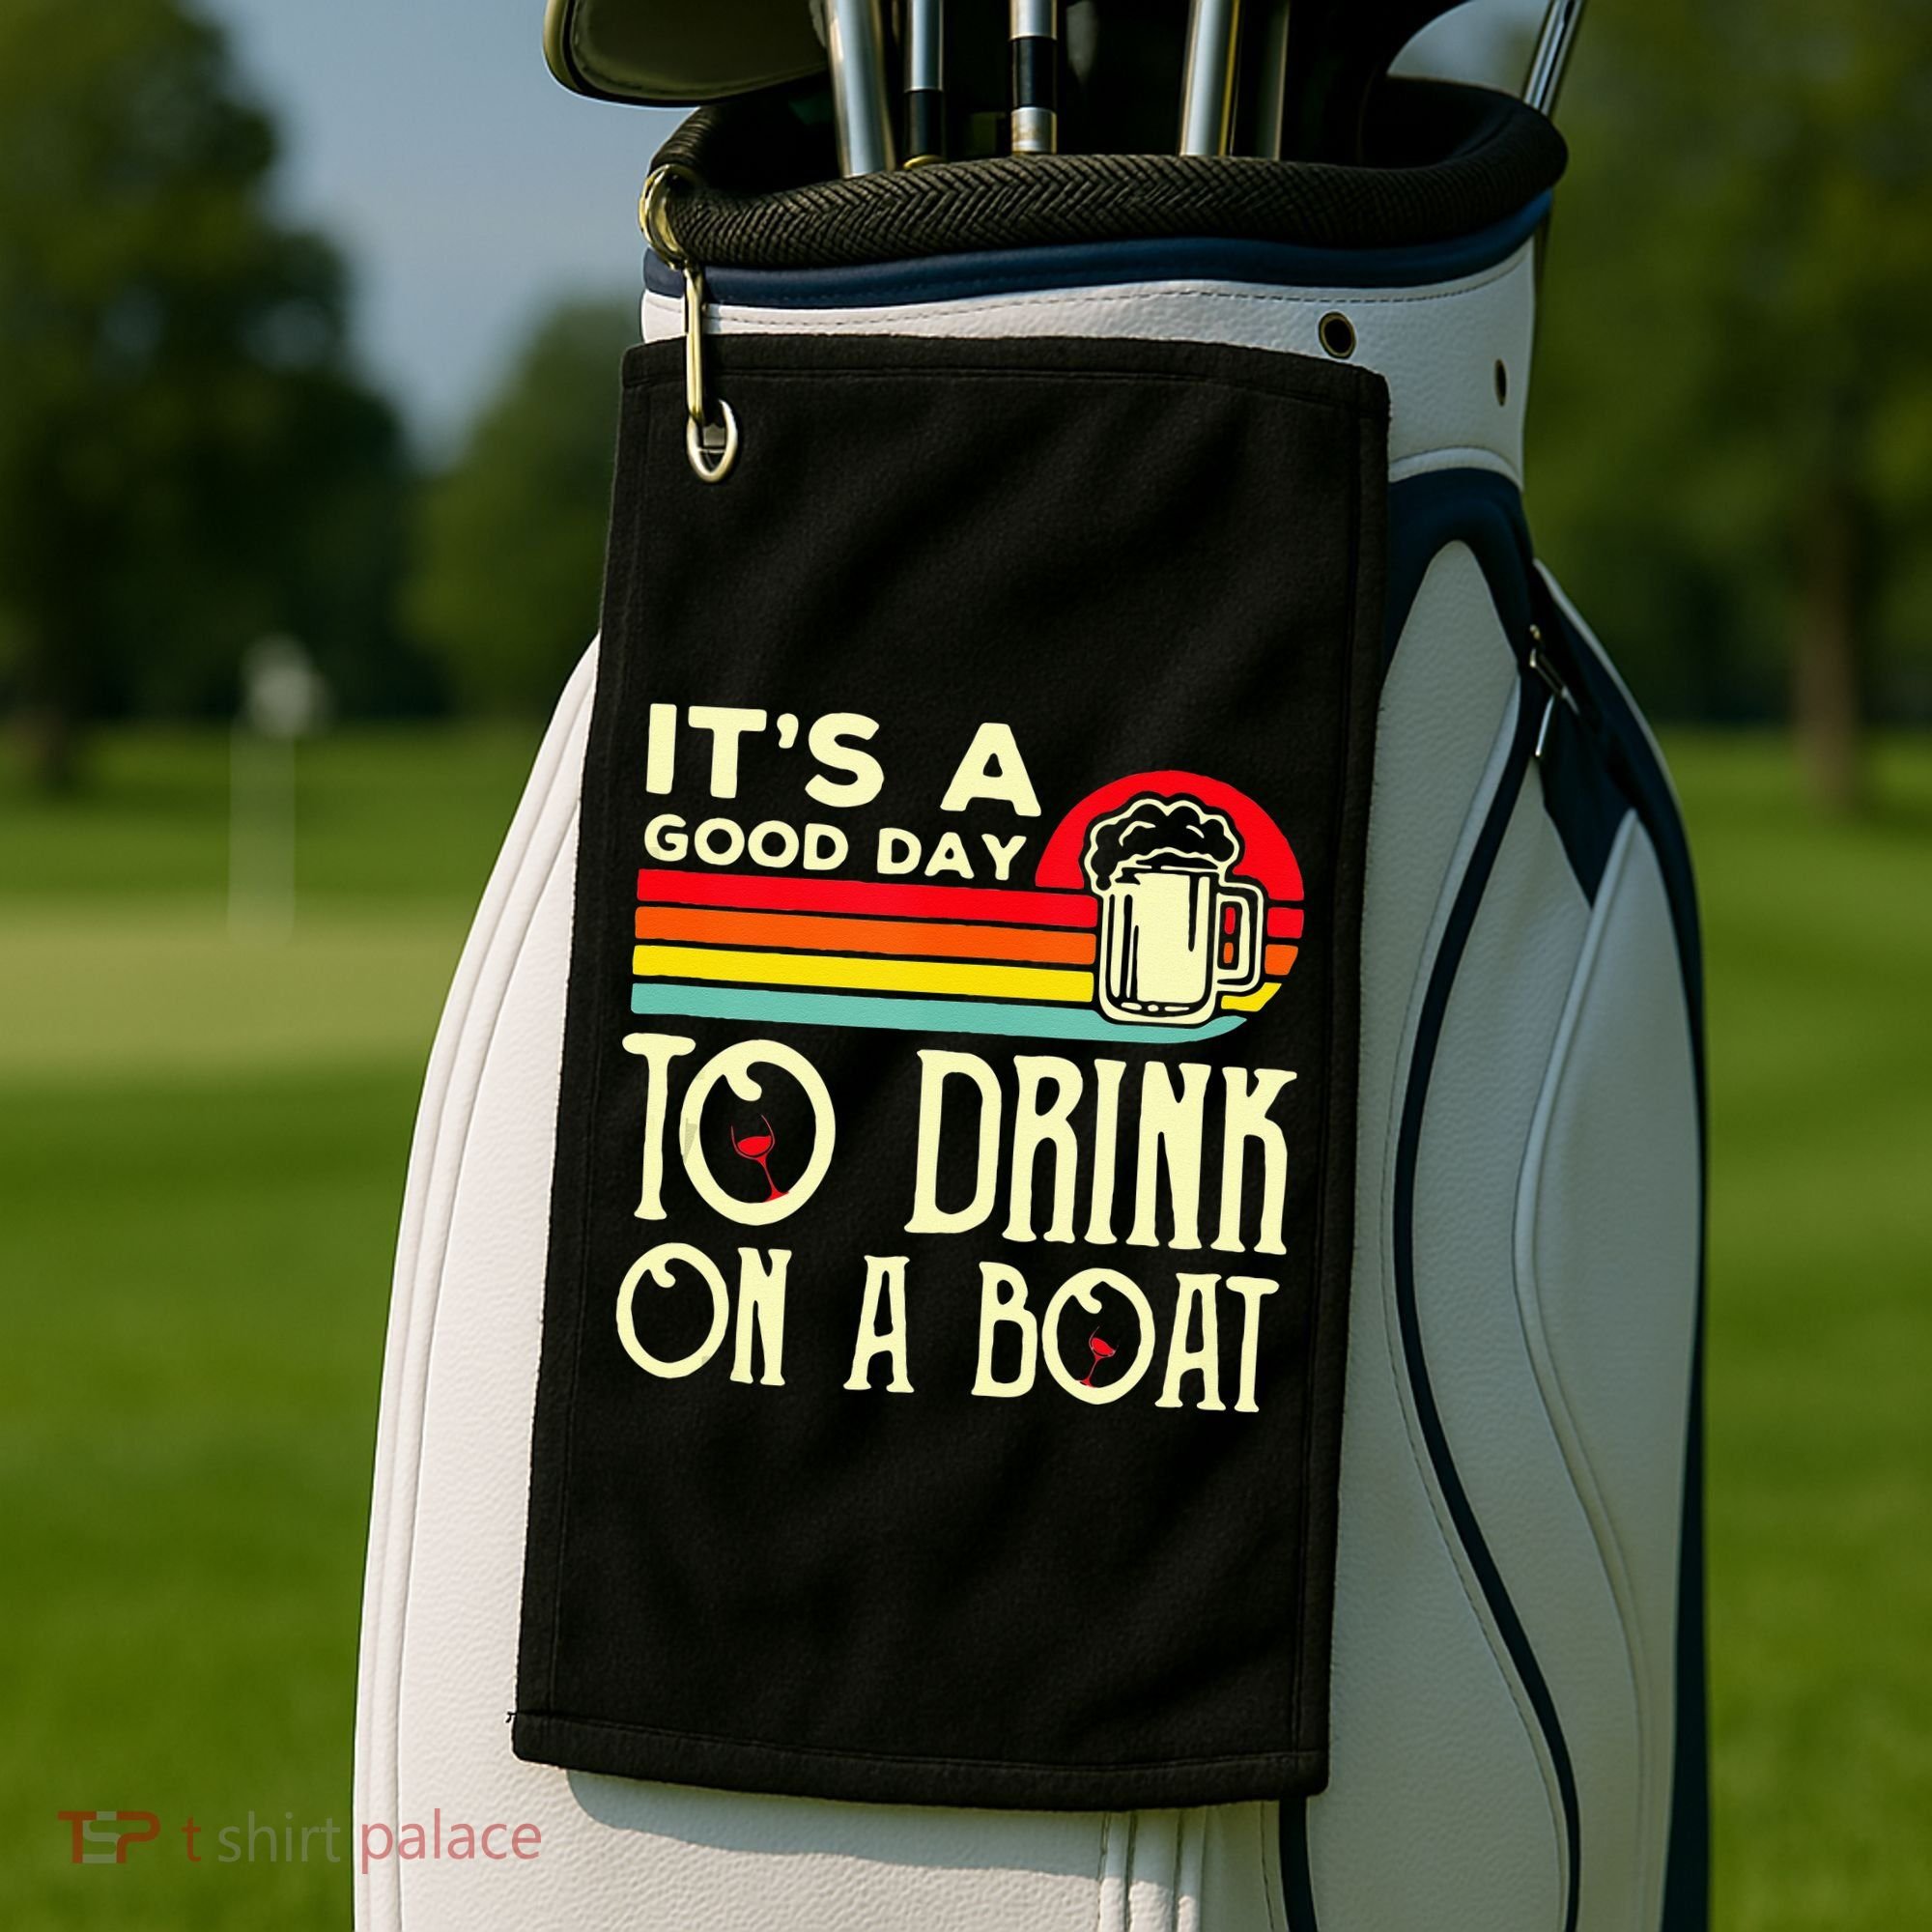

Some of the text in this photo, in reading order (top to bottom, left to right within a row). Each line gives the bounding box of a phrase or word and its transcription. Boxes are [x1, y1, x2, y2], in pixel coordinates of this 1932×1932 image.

[645, 703, 1042, 817] IT'S A
[643, 813, 1027, 881] GOOD DAY
[621, 1032, 1297, 1256] TO DRINK
[615, 1242, 1280, 1413] ON A BOAT
